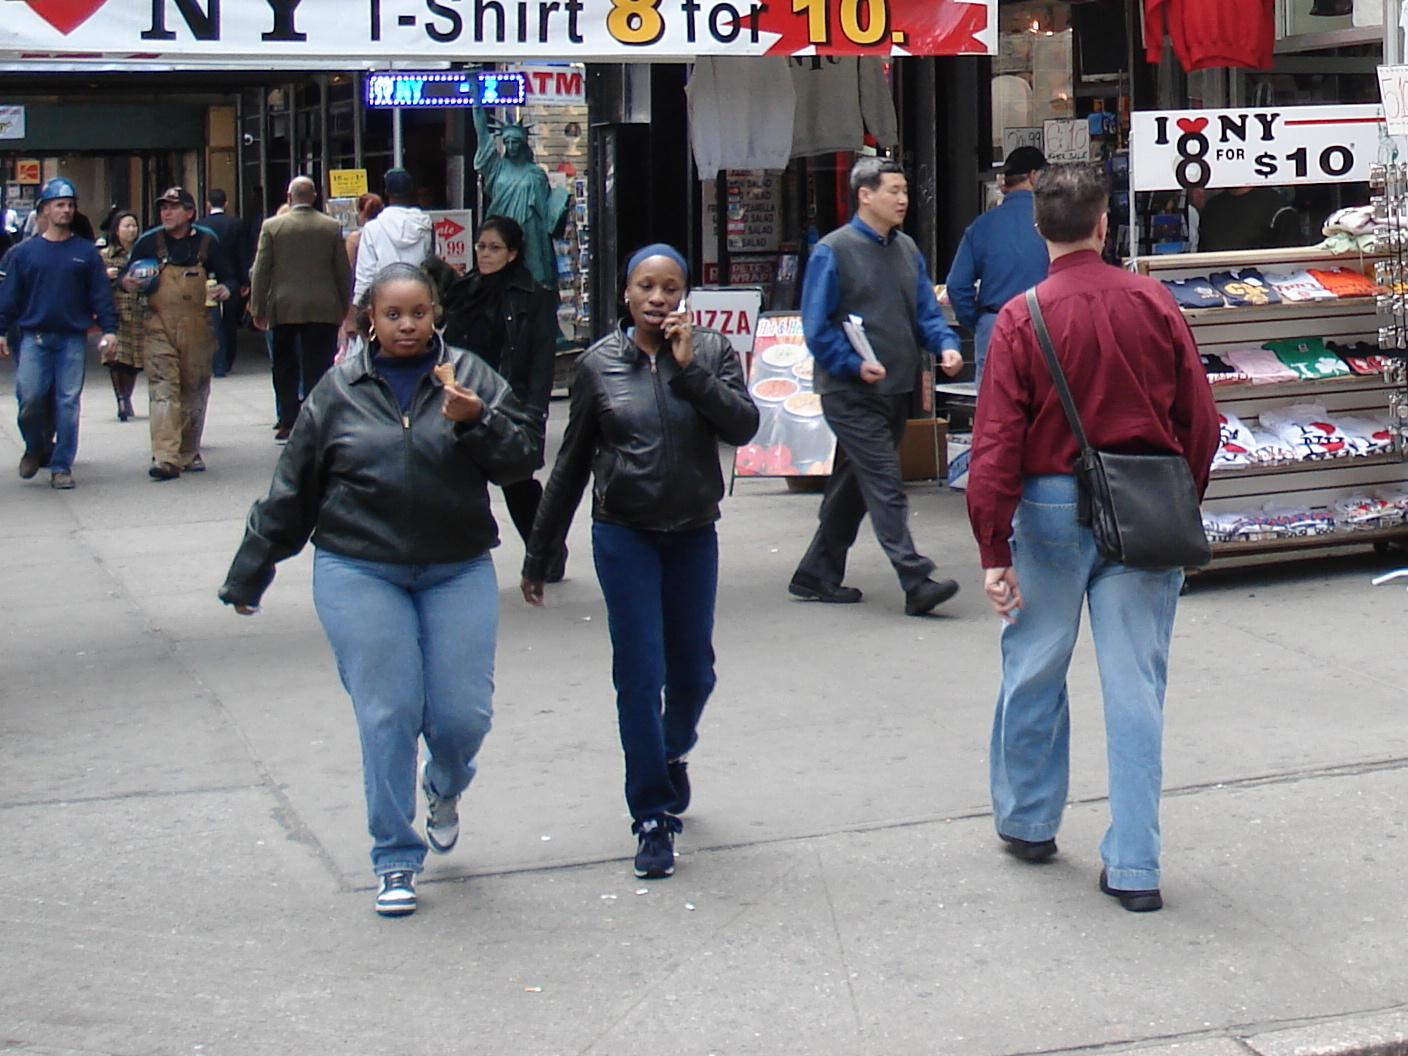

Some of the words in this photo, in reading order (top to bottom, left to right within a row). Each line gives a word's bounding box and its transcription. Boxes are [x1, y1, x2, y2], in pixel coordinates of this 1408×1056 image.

[524, 71, 581, 95] ATM
[1154, 116, 1170, 145] I
[1218, 113, 1281, 143] NY
[1175, 131, 1212, 189] 8
[1216, 148, 1246, 161] FOR
[1254, 144, 1355, 179] $10
